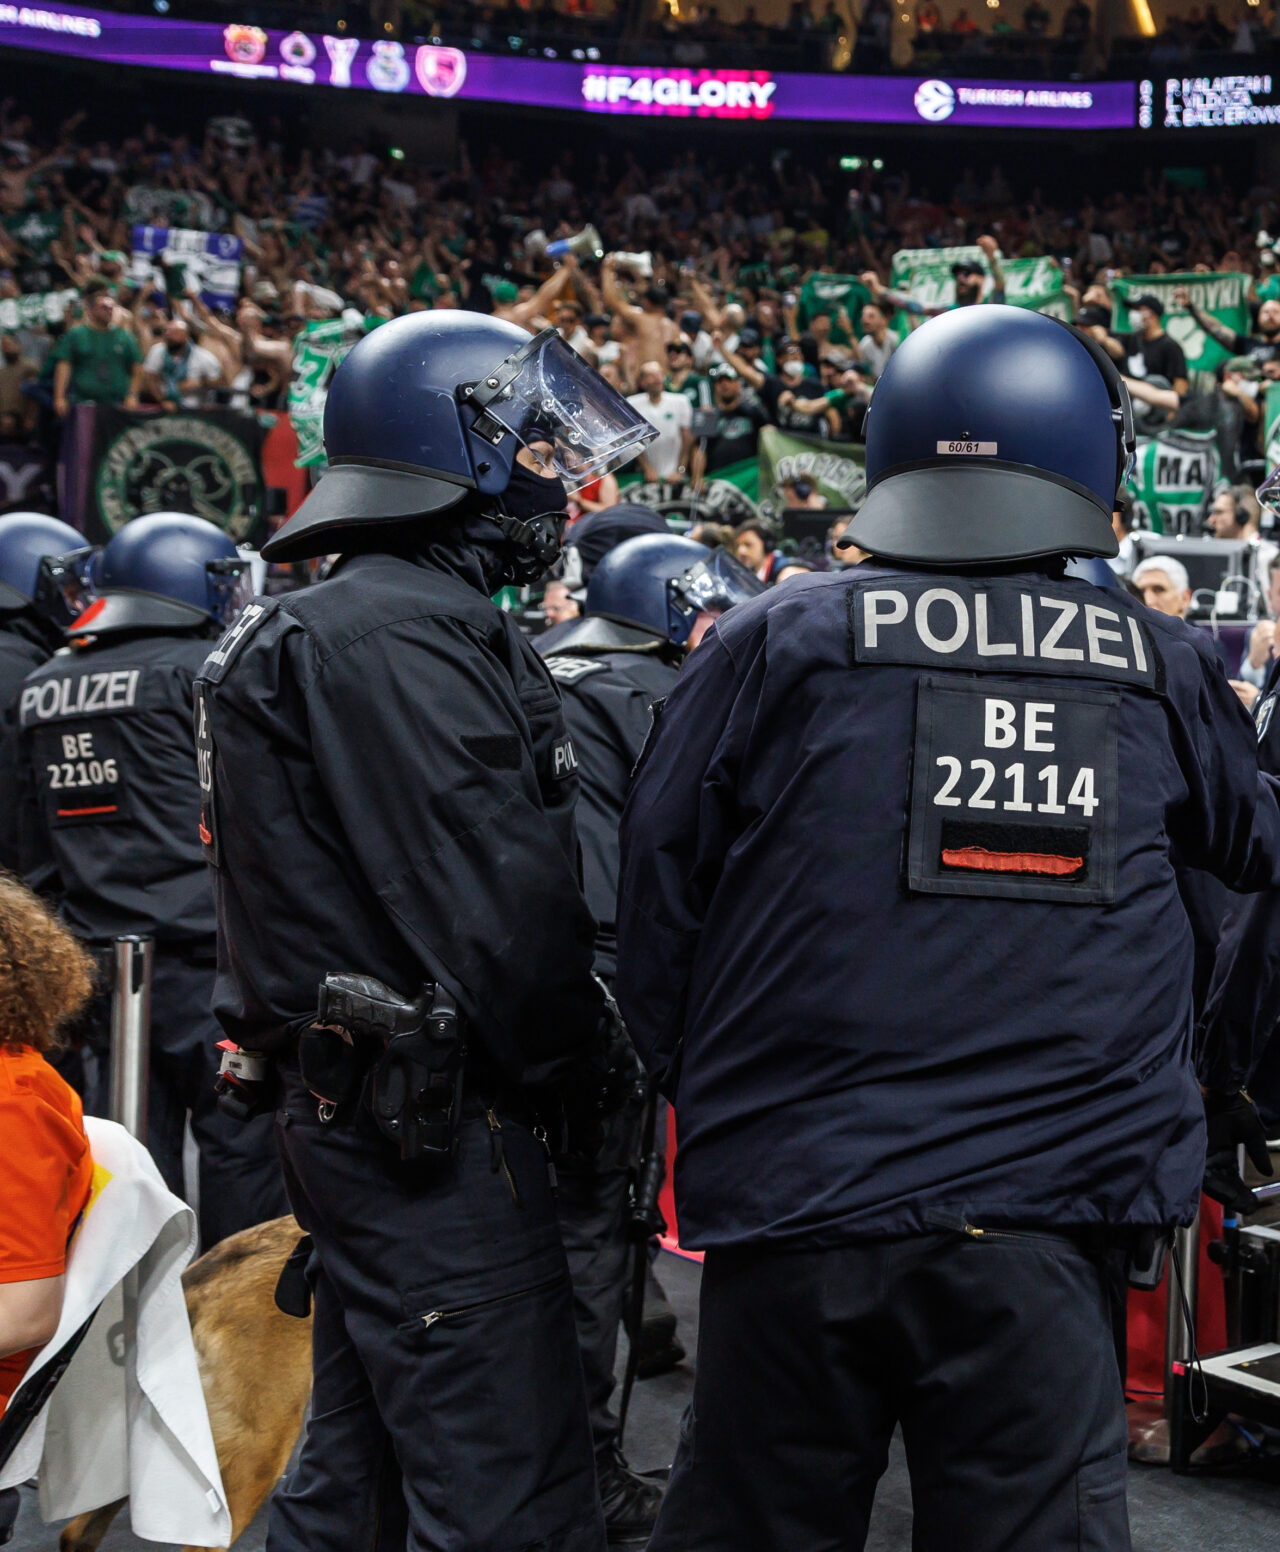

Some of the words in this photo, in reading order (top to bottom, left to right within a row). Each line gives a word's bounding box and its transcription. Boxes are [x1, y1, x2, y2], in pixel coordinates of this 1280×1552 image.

[582, 75, 777, 109] #F4GLORY
[957, 87, 1025, 107] TURKISH
[1025, 89, 1093, 109] AIRLINES
[948, 442, 980, 453] 60/61
[863, 588, 1148, 673] POLIZEI
[20, 669, 140, 727] POLIZEI
[984, 698, 1055, 752] BE
[61, 732, 95, 760] BE
[47, 758, 119, 789] 22106
[933, 755, 1099, 817] 22114
